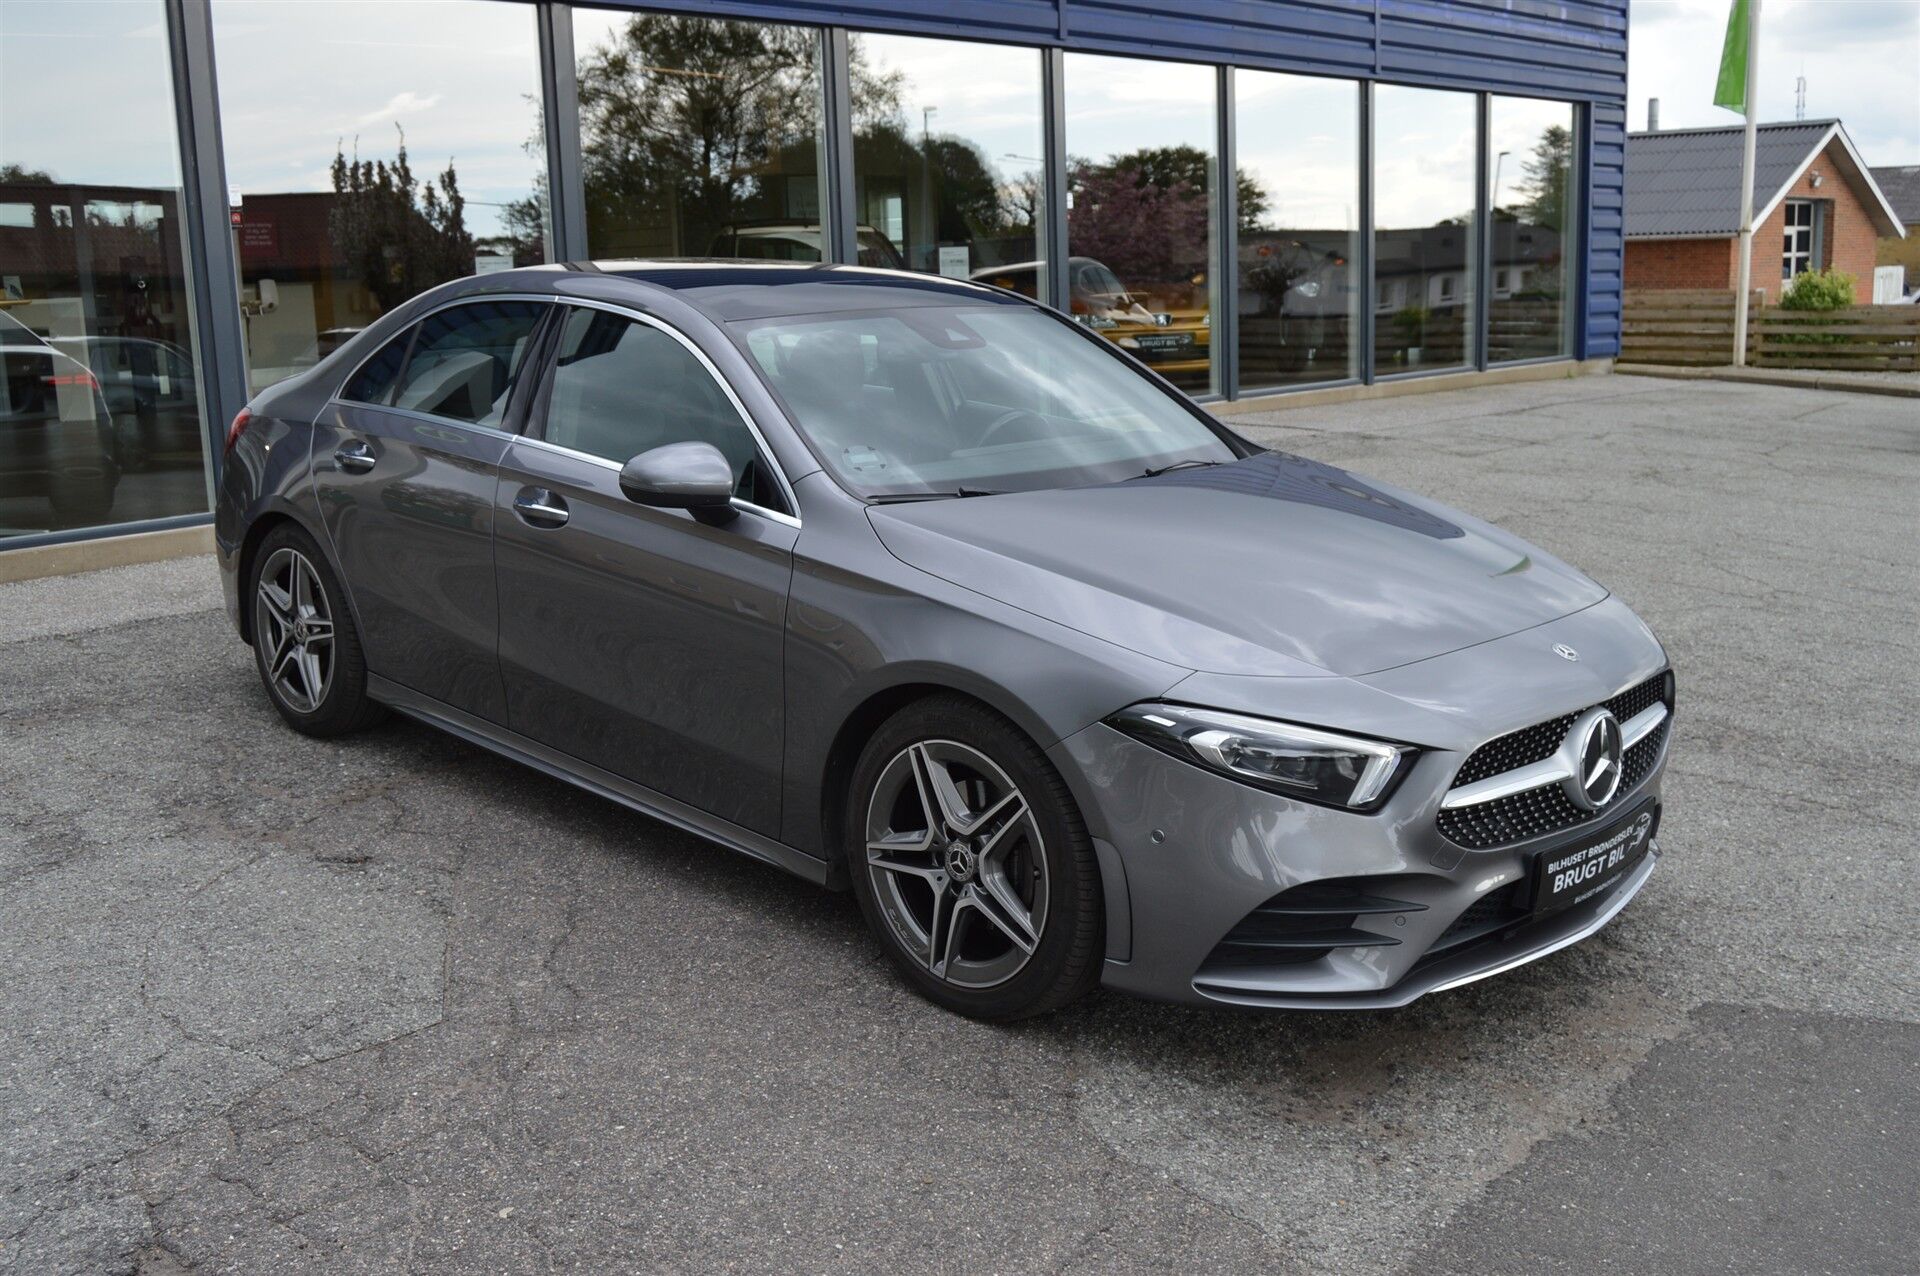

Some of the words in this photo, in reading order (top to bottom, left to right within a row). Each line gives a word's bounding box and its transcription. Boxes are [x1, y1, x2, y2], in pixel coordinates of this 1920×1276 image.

[1548, 850, 1587, 874] BILHUSET
[1553, 855, 1607, 893] BRUGT
[1608, 844, 1625, 868] BIL
